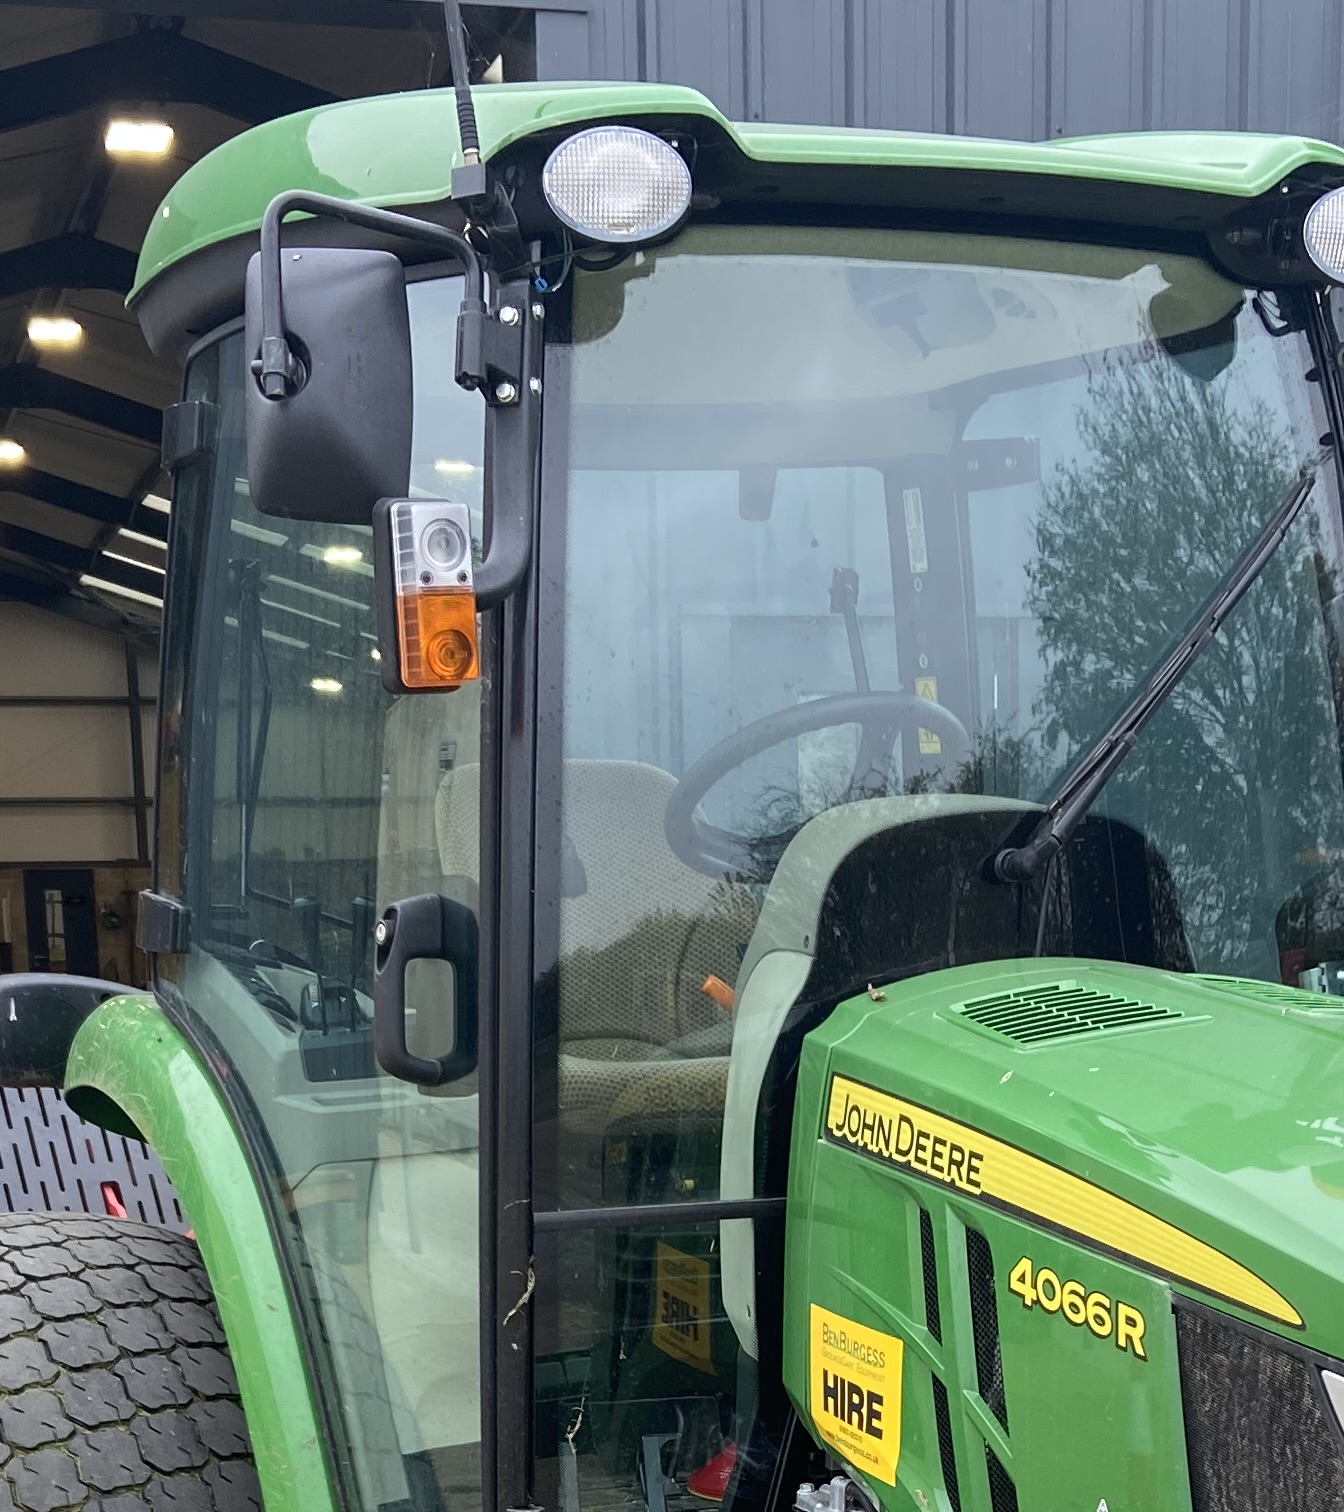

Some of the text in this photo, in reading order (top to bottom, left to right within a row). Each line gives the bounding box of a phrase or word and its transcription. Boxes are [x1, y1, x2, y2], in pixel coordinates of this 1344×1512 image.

[835, 1093, 985, 1189] JOHN DEERE
[1009, 1255, 1148, 1362] 4066R
[822, 1367, 885, 1441] HIRE
